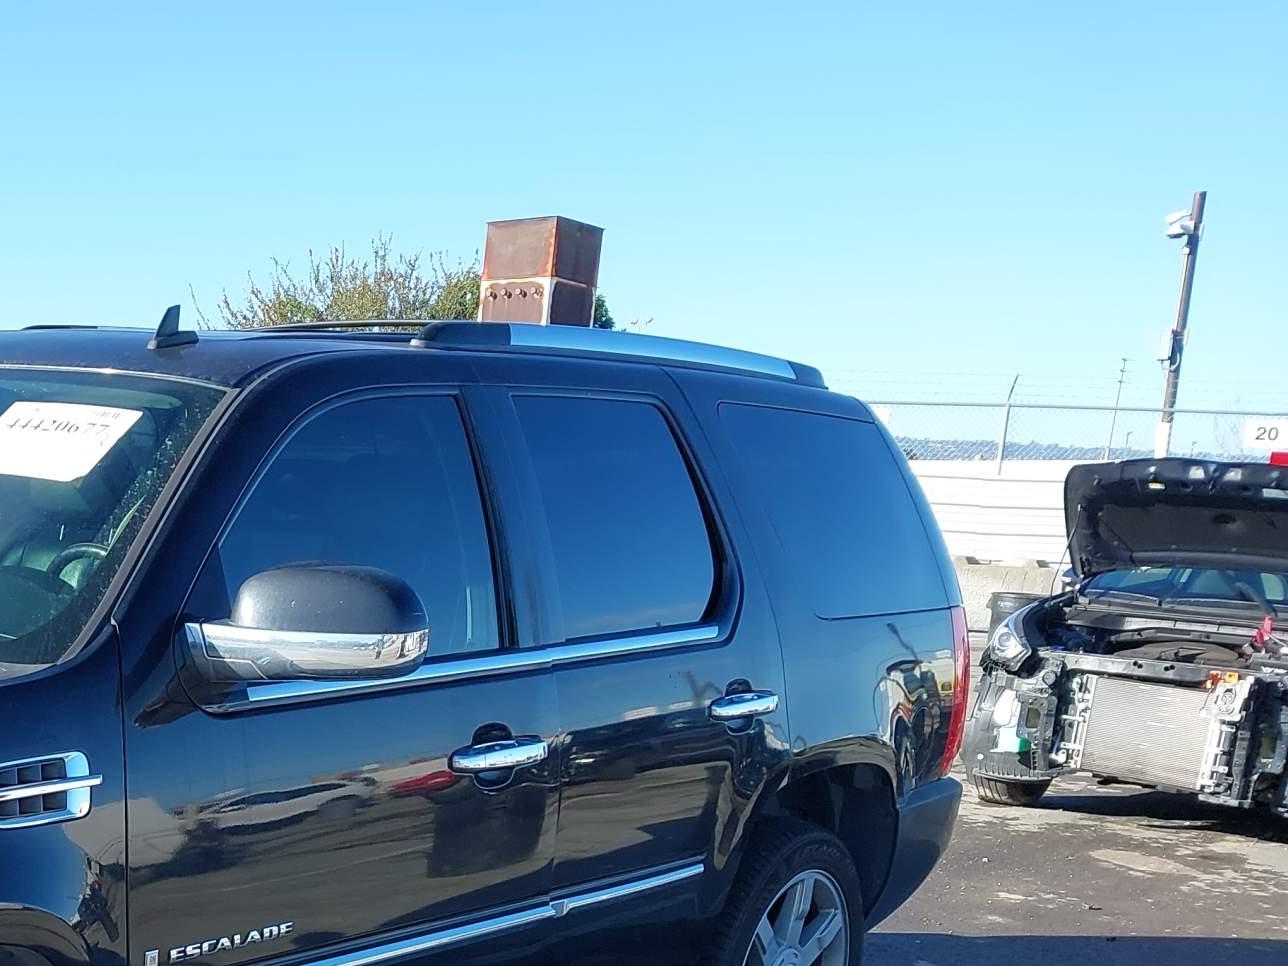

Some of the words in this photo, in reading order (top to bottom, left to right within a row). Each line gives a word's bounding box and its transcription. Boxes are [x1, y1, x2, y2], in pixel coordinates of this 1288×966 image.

[7, 417, 111, 434] 44420677
[1255, 427, 1279, 441] 20
[169, 922, 294, 963] ESCALADE
